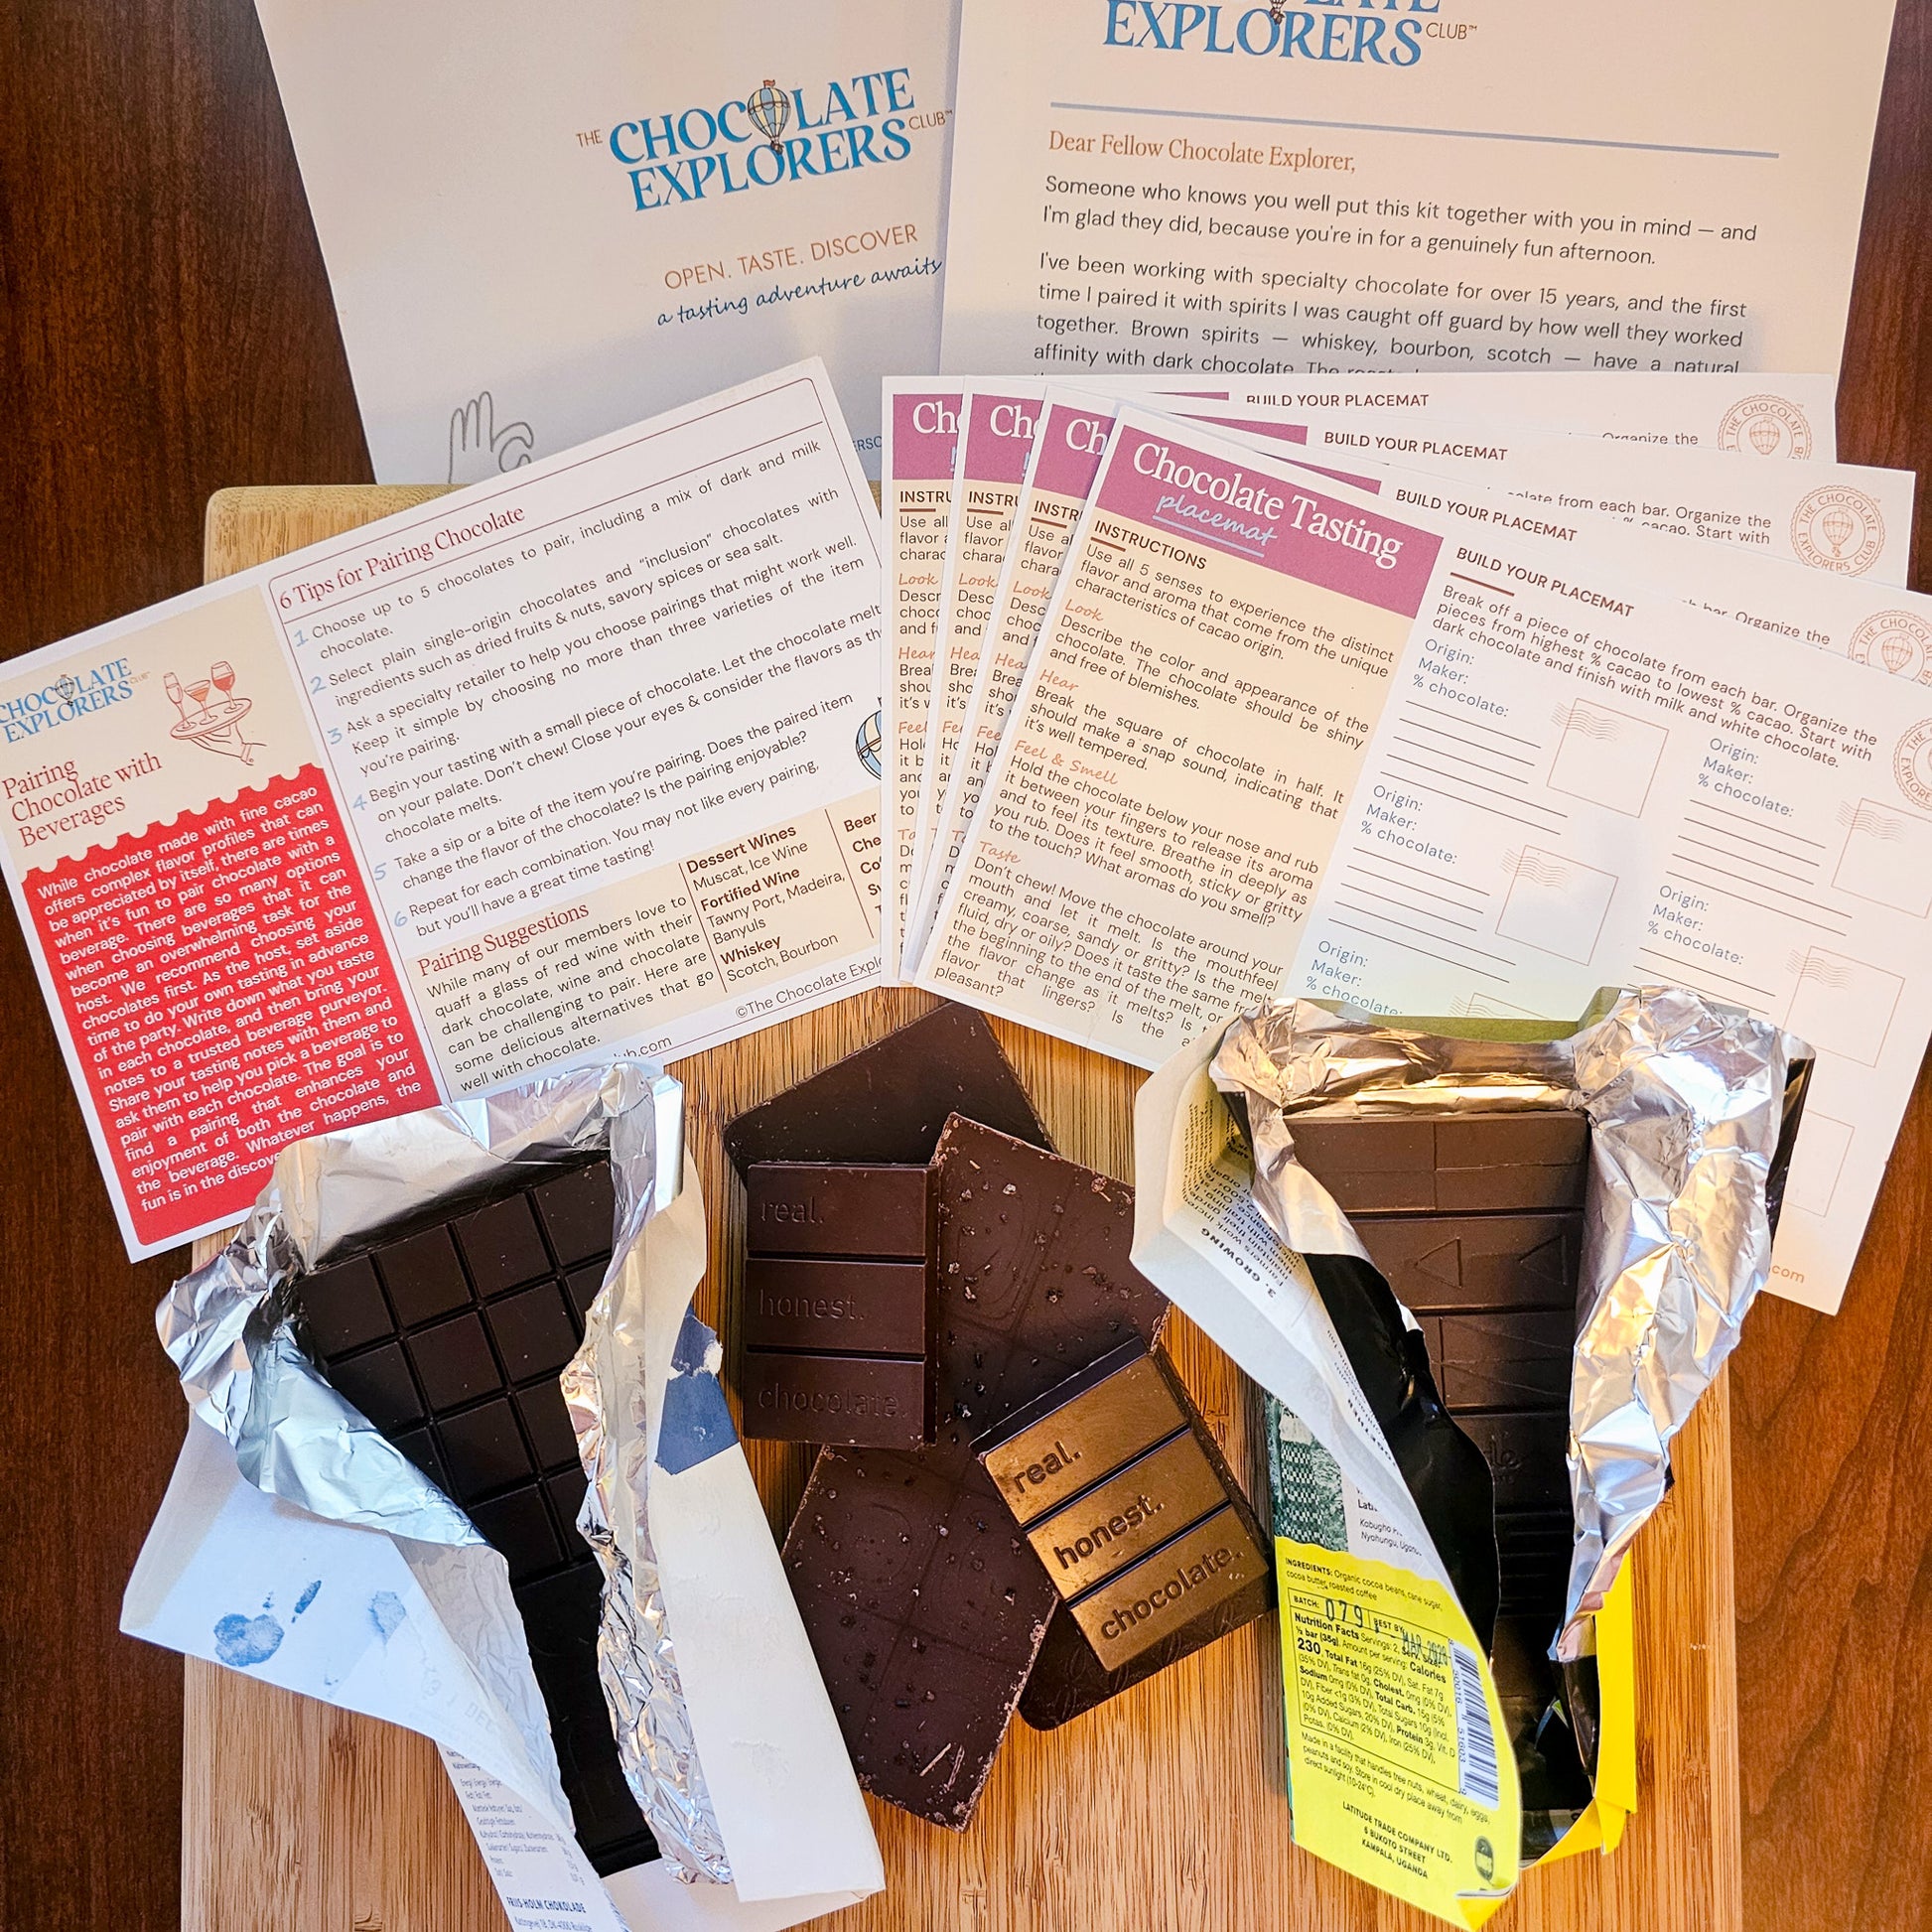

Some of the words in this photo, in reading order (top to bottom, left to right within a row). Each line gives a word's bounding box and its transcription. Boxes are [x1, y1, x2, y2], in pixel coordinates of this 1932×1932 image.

[1103, 0, 1423, 66] EXPLORERS
[576, 130, 603, 147] THE
[1049, 130, 1096, 152] Dear
[1101, 134, 1164, 157] Fellow
[1169, 138, 1264, 164] Chocolate
[1269, 146, 1355, 174] Explorer,
[628, 118, 911, 211] EXPLORERS
[1043, 205, 1069, 224] I'm
[1075, 208, 1115, 230] glad
[1121, 211, 1164, 235] they
[1169, 214, 1202, 236] did,
[1209, 217, 1290, 239] because
[1296, 225, 1351, 245] you're
[1357, 227, 1373, 245] in
[1380, 229, 1406, 247] for
[1411, 236, 1422, 248] a
[1427, 235, 1519, 259] genuinely
[1524, 239, 1554, 257] fun
[1559, 242, 1655, 264] afternoon.
[664, 261, 732, 289] OPEN.
[737, 247, 804, 275] TASTE.
[810, 223, 918, 261] DISCOVER
[657, 314, 673, 326] a
[677, 297, 748, 324] tasting
[756, 274, 866, 307] adventure
[871, 256, 942, 284] awaits
[1297, 394, 1339, 407] YOUR
[1345, 394, 1429, 407] PLACEMAT
[1324, 431, 1370, 447] BUILD
[1375, 437, 1418, 453] YOUR
[1423, 441, 1508, 461] PLACEMAT
[1134, 443, 1284, 520] Chocolate
[1290, 494, 1404, 570] Tasting
[1156, 493, 1278, 546] placemat
[1396, 488, 1442, 509] BUILD
[1447, 500, 1489, 521] YOUR
[1492, 511, 1578, 541] PLACEMAT
[1800, 503, 1816, 523] THE
[1818, 493, 1876, 531] CHOCOLATE
[312, 613, 366, 639] Choose
[372, 603, 391, 617] up
[398, 595, 413, 607] to
[420, 586, 430, 599] 5
[437, 557, 514, 592] chocolates
[521, 548, 537, 560] to
[543, 534, 575, 556] pair,
[579, 507, 645, 539] including
[650, 502, 660, 512] a
[666, 489, 692, 506] mix
[698, 479, 713, 494] of
[720, 466, 752, 486] dark
[759, 452, 785, 473] and
[791, 440, 821, 460] milk
[899, 532, 939, 544] flavor
[1094, 520, 1207, 570] INSTRUCTIONS
[1798, 533, 1850, 571] EXPLORERS
[1855, 541, 1875, 565] CLUB
[280, 592, 292, 610] 6
[292, 580, 335, 603] Tips
[337, 568, 362, 588] for
[365, 543, 434, 577] Pairing
[434, 508, 525, 550] Chocolate
[898, 573, 939, 586] Look
[959, 573, 998, 587] Look
[1456, 547, 1502, 571] BUILD
[1507, 564, 1548, 588] YOUR
[1550, 580, 1634, 617] PLACEMAT
[1064, 599, 1104, 621] Look
[1086, 544, 1113, 563] Use
[1118, 558, 1135, 571] all
[1139, 563, 1150, 576] 5
[1155, 572, 1203, 596] senses
[1209, 590, 1223, 603] to
[1229, 599, 1307, 631] experience
[1312, 625, 1335, 642] the
[1340, 635, 1394, 663] distinct
[320, 627, 393, 659] chocolate.
[1425, 638, 1474, 665] Origin:
[1039, 668, 1079, 691] Hear
[1418, 657, 1468, 684] Maker:
[1443, 585, 1484, 609] Break
[1488, 604, 1511, 618] off
[1513, 613, 1523, 622] a
[1526, 617, 1569, 637] piece
[1574, 632, 1590, 644] of
[1593, 639, 1666, 672] chocolate
[1671, 663, 1706, 686] from
[1711, 681, 1746, 700] each
[1751, 692, 1777, 712] bar.
[1784, 704, 1848, 736] Organize
[1854, 729, 1877, 746] the
[4, 680, 133, 743] EXPLORERS
[1429, 682, 1509, 717] chocolate:
[1014, 740, 1048, 759] Feel
[1069, 759, 1118, 785] Smell
[1703, 756, 1753, 784] Maker:
[1710, 738, 1759, 764] Origin:
[1, 760, 78, 799] Pairing
[12, 774, 112, 822] Chocolate
[114, 752, 163, 782] with
[1714, 781, 1794, 817] chocolate:
[18, 796, 125, 848] Beverages
[37, 878, 78, 898] While
[83, 849, 153, 883] chocolate
[158, 831, 199, 854] made
[204, 816, 235, 836] with
[239, 805, 268, 822] fine
[273, 787, 318, 809] cacao
[686, 843, 747, 875] Dessert
[749, 825, 797, 855] Wines
[979, 840, 1022, 865] Taste
[693, 865, 749, 892] Muscat,
[749, 857, 770, 871] Ice
[771, 843, 808, 861] Wine
[700, 880, 761, 911] Fortified
[761, 869, 799, 889] Wine
[706, 905, 750, 928] Tawny
[752, 894, 785, 912] Port,
[786, 873, 845, 899] Madeira,
[417, 943, 483, 977] Pairing
[483, 904, 589, 952] Suggestions
[713, 918, 766, 945] Banyuls
[720, 936, 780, 965] Whiskey
[727, 956, 778, 982] Scotch,
[779, 934, 839, 963] Bourbon
[934, 967, 1004, 997] pleasant?
[131, 1142, 208, 1178] enjoyment
[214, 1131, 229, 1147] of
[235, 1118, 271, 1139] both
[277, 1108, 303, 1123] the
[309, 1078, 381, 1112] chocolate
[387, 1061, 416, 1082] and
[761, 1197, 823, 1224] real.
[759, 1289, 864, 1319] honest.
[758, 1384, 906, 1418] chocolate.
[1013, 1441, 1081, 1493] real.
[1053, 1493, 1164, 1569] honest.
[1286, 1558, 1332, 1576] INGREDIENTS:
[1334, 1570, 1360, 1584] Organic
[1363, 1579, 1383, 1589] cocoa
[1100, 1546, 1242, 1642] chocolate.
[1294, 1596, 1319, 1608] BATCH:
[1295, 1612, 1332, 1631] Nutrition
[1335, 1624, 1359, 1639] Facts
[1325, 1650, 1343, 1663] Total
[1345, 1656, 1358, 1667] Fat
[1410, 1662, 1447, 1683] Calories
[1342, 1801, 1373, 1823] LATITUDE
[1374, 1819, 1396, 1836] TRADE
[1397, 1829, 1435, 1853] COMPANY
[1437, 1849, 1451, 1863] LTD.
[1370, 1829, 1397, 1850] BUKOTO
[1399, 1845, 1426, 1863] STREET
[1362, 1839, 1395, 1863] KAMPALA,
[1397, 1856, 1428, 1878] UGANDA
